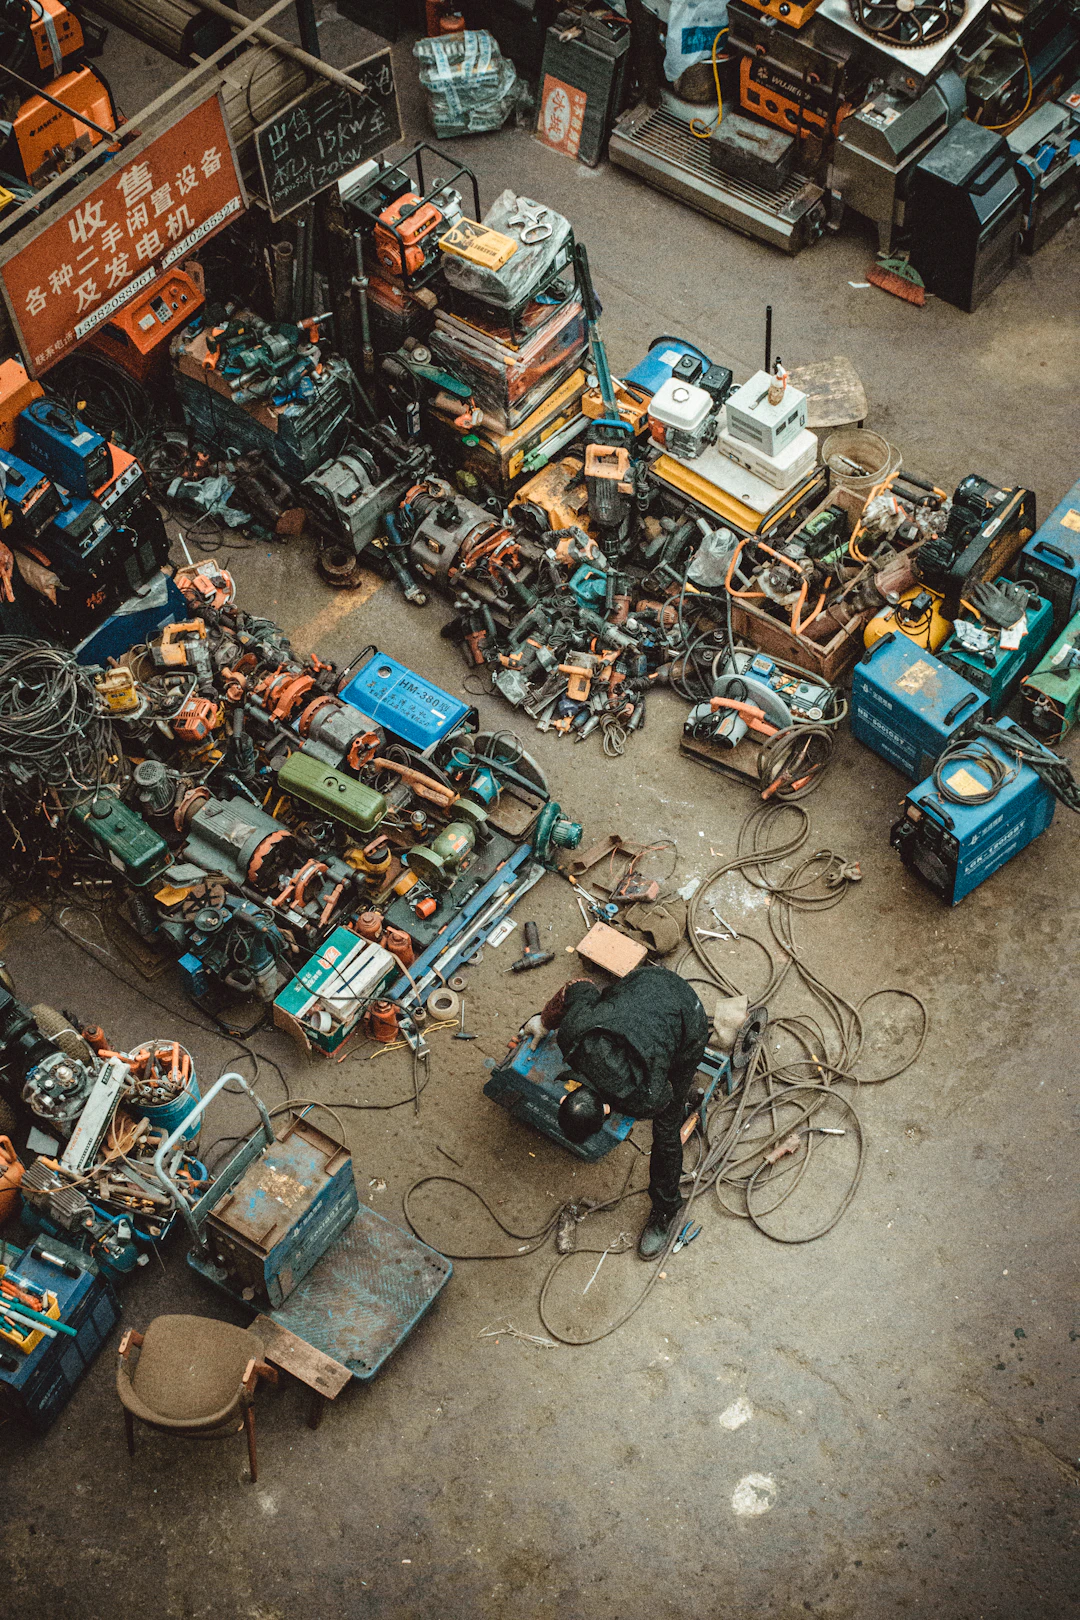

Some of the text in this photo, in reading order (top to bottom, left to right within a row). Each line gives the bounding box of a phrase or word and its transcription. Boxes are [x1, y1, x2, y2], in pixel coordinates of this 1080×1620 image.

[25, 146, 222, 317] 各种二手闲置设备
[68, 160, 153, 244] 收售
[73, 204, 195, 314] 及发电机
